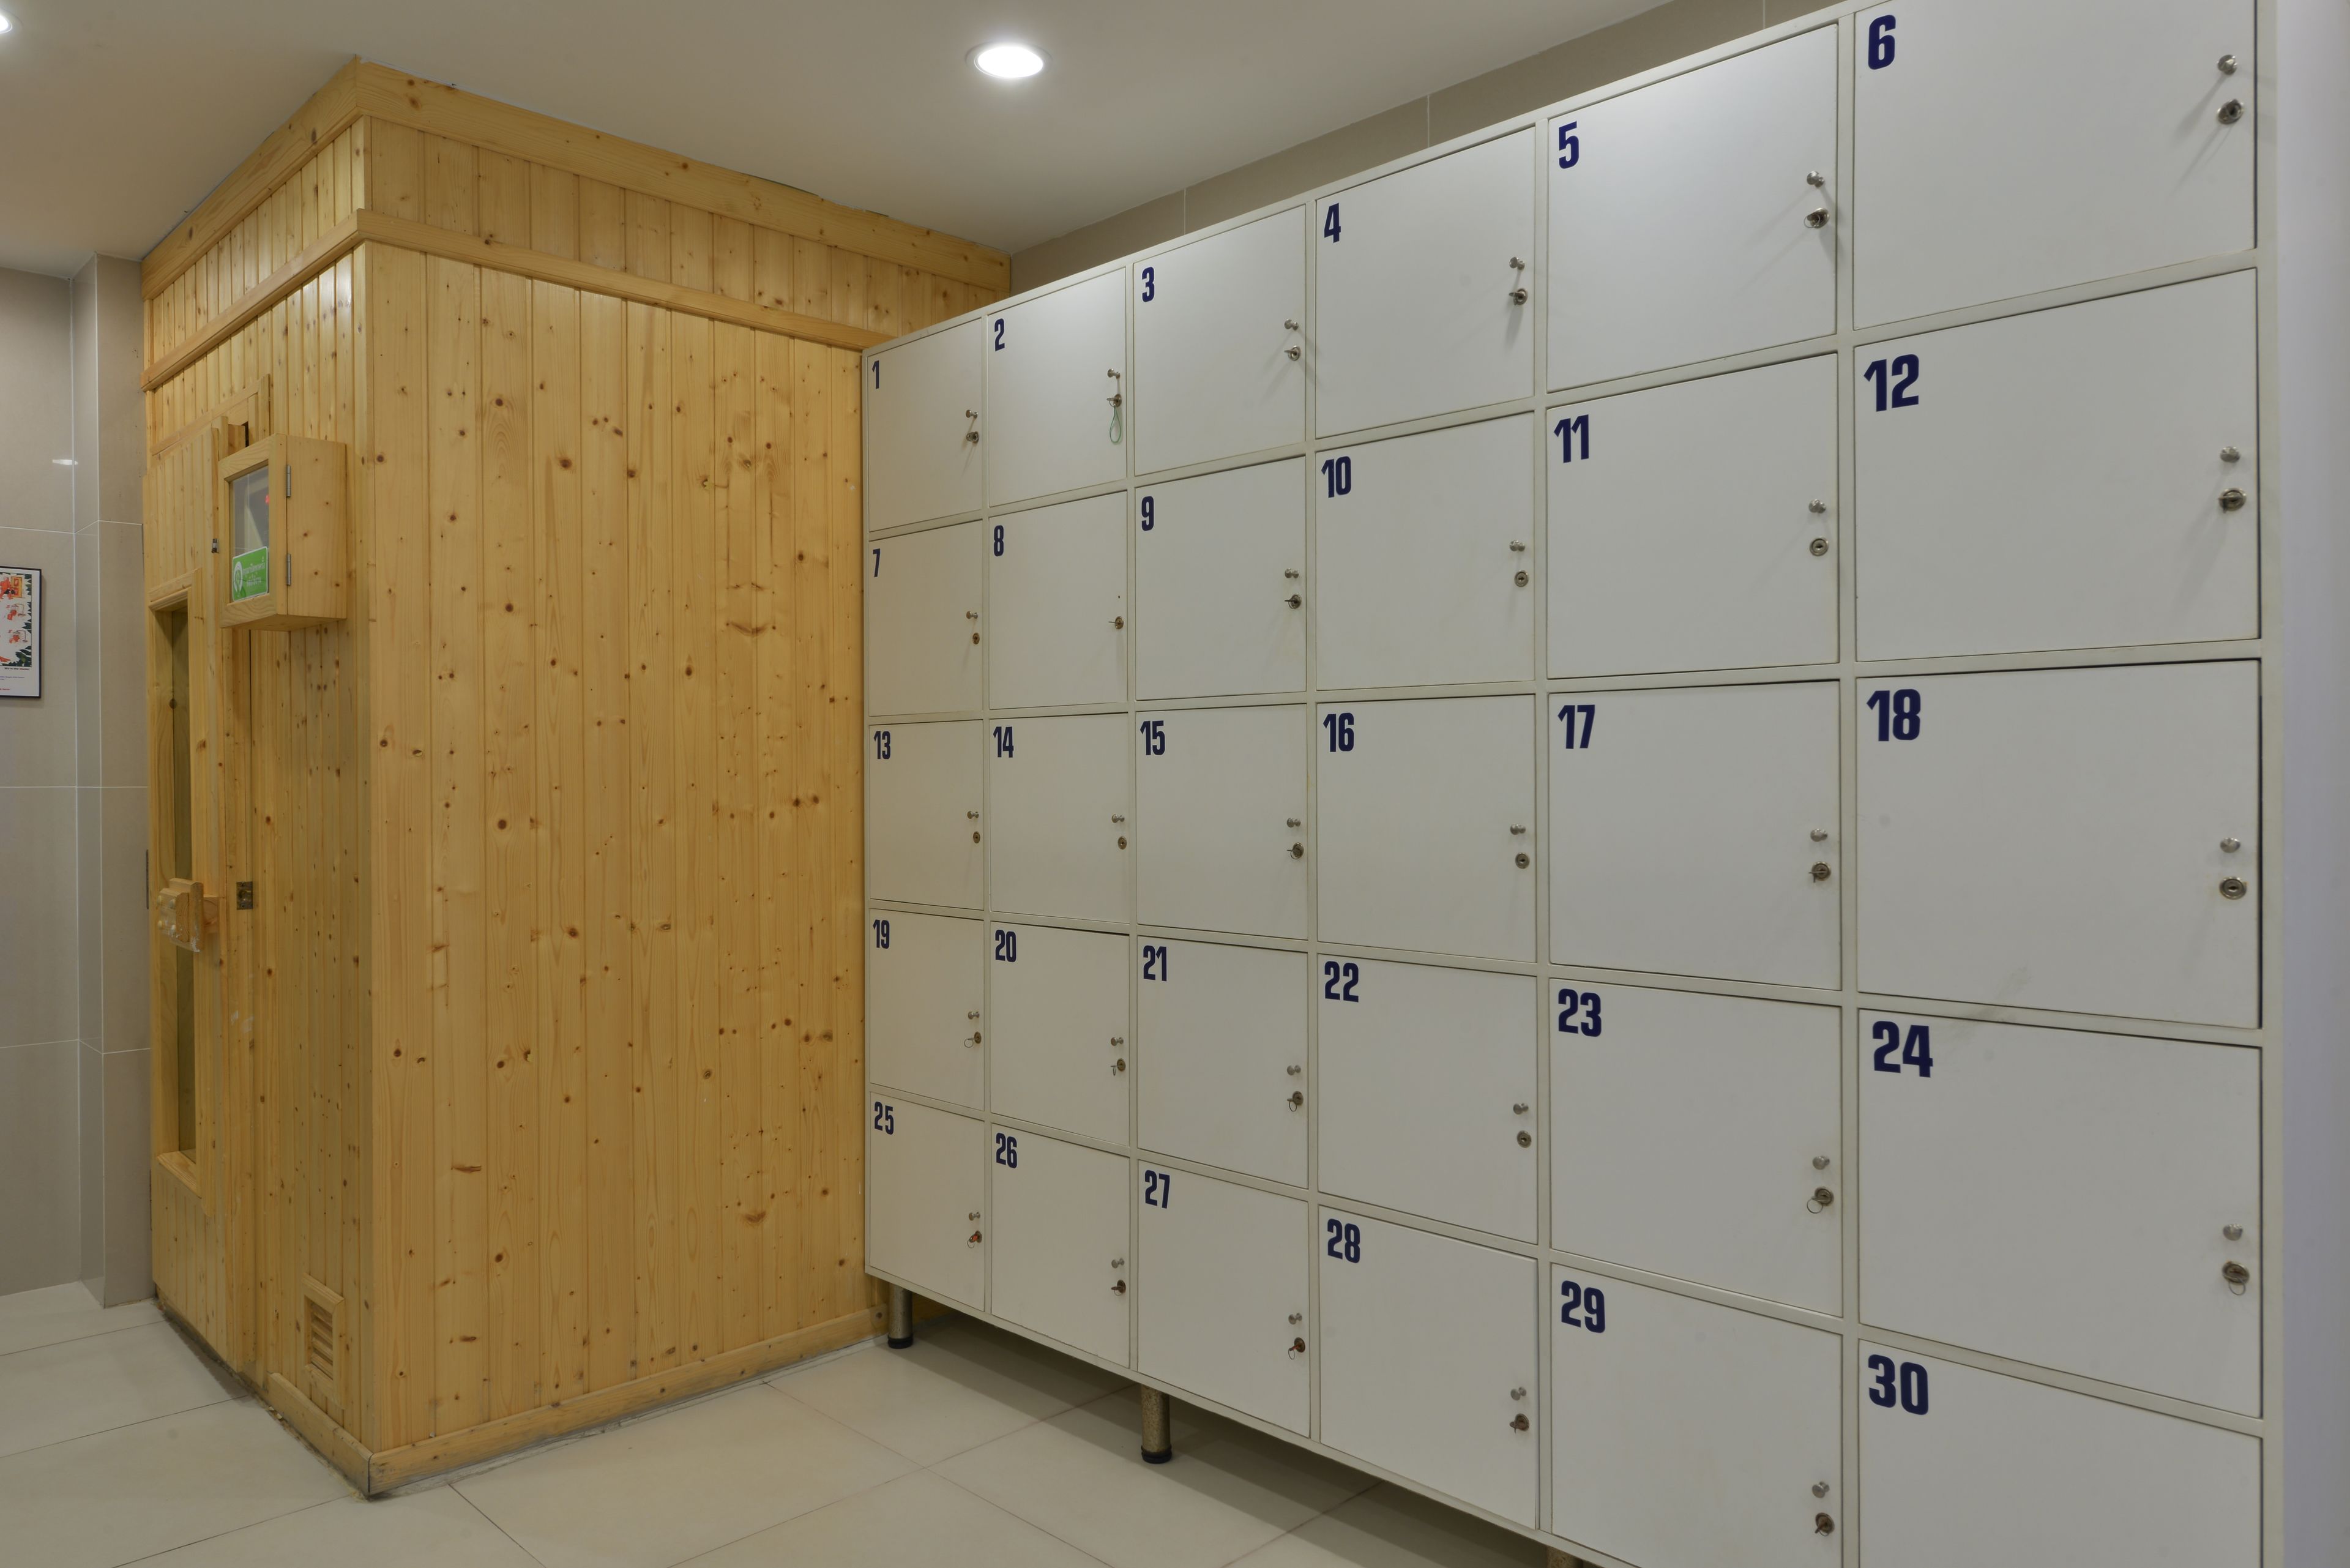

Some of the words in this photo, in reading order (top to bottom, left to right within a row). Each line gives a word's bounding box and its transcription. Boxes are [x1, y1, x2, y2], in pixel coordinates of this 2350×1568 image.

[1868, 14, 1896, 70] 6
[1558, 121, 1580, 170] 5
[1324, 203, 1341, 244] 4
[1141, 266, 1155, 303] 3
[994, 318, 1005, 351] 2
[871, 360, 879, 389] 1
[1863, 354, 1919, 412] 12
[1553, 414, 1589, 463] 11
[1321, 456, 1352, 498] 10
[1141, 496, 1154, 532] 9
[993, 525, 1004, 557] 8
[872, 548, 881, 578] 7
[1322, 712, 1354, 753] 16
[1557, 704, 1595, 750] 17
[1867, 689, 1921, 742] 18
[873, 731, 891, 760] 13
[993, 726, 1014, 758] 14
[1140, 720, 1165, 756] 15
[873, 919, 890, 949] 19
[994, 929, 1016, 963] 20
[1143, 945, 1167, 982] 21
[1324, 961, 1359, 1002] 22
[1558, 988, 1602, 1037] 23
[1872, 1020, 1933, 1078] 24
[874, 1101, 894, 1135] 25
[996, 1132, 1018, 1169] 26
[1144, 1170, 1170, 1209] 27
[1327, 1219, 1360, 1264] 28
[1561, 1280, 1606, 1334] 29
[1868, 1354, 1929, 1416] 30
